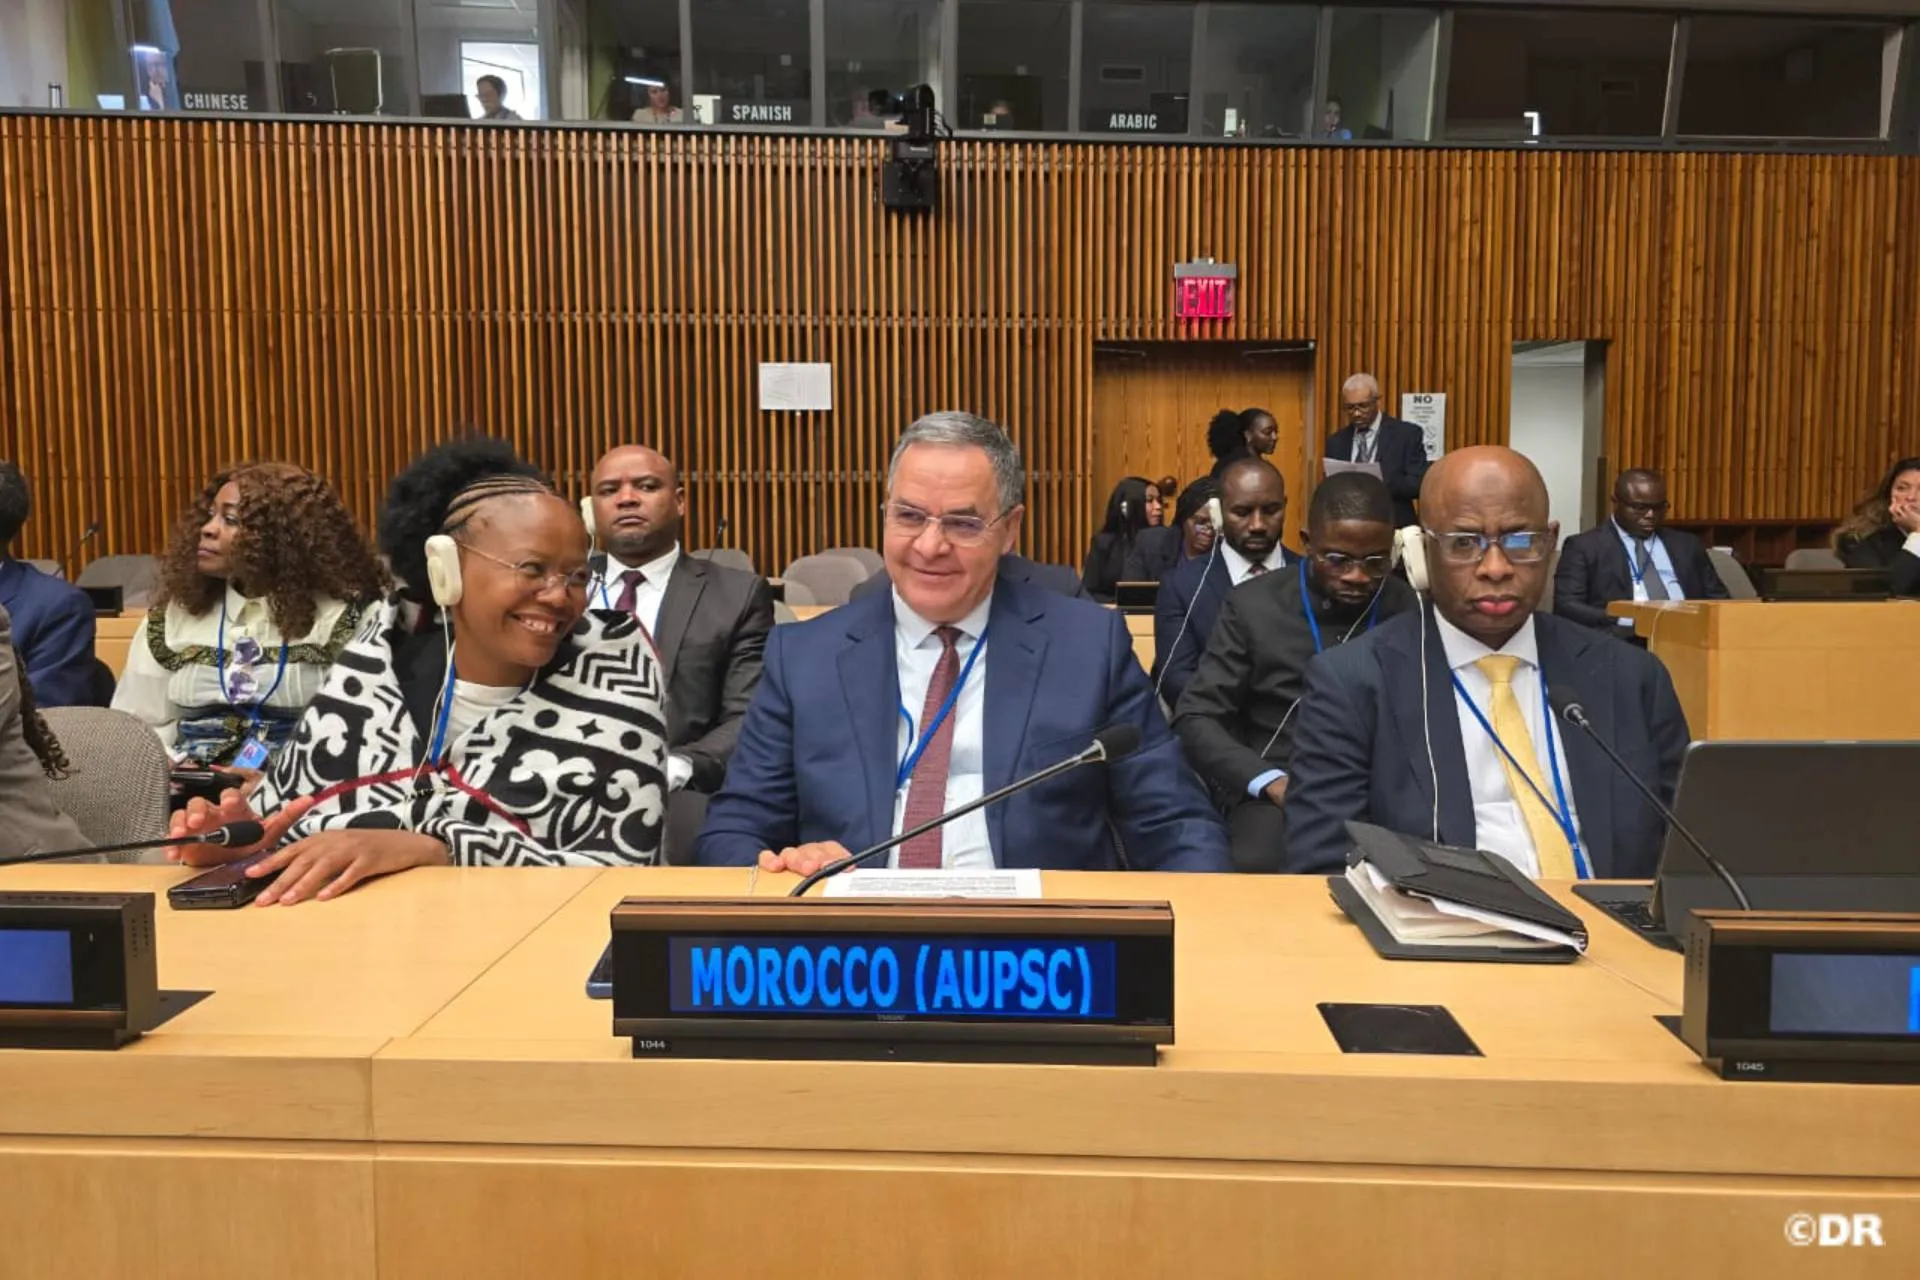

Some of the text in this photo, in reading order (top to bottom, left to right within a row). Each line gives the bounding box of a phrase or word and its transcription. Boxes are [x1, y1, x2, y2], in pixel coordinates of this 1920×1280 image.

[184, 92, 249, 110] CHINESE
[732, 104, 792, 121] SPANISH
[1109, 113, 1157, 129] ARABIC
[1183, 279, 1227, 315] EXIT
[1413, 395, 1433, 404] NO
[691, 945, 1091, 1015] MOROCCO (AUPSC)
[640, 1040, 666, 1049] 1044
[1736, 1062, 1765, 1071] 1045
